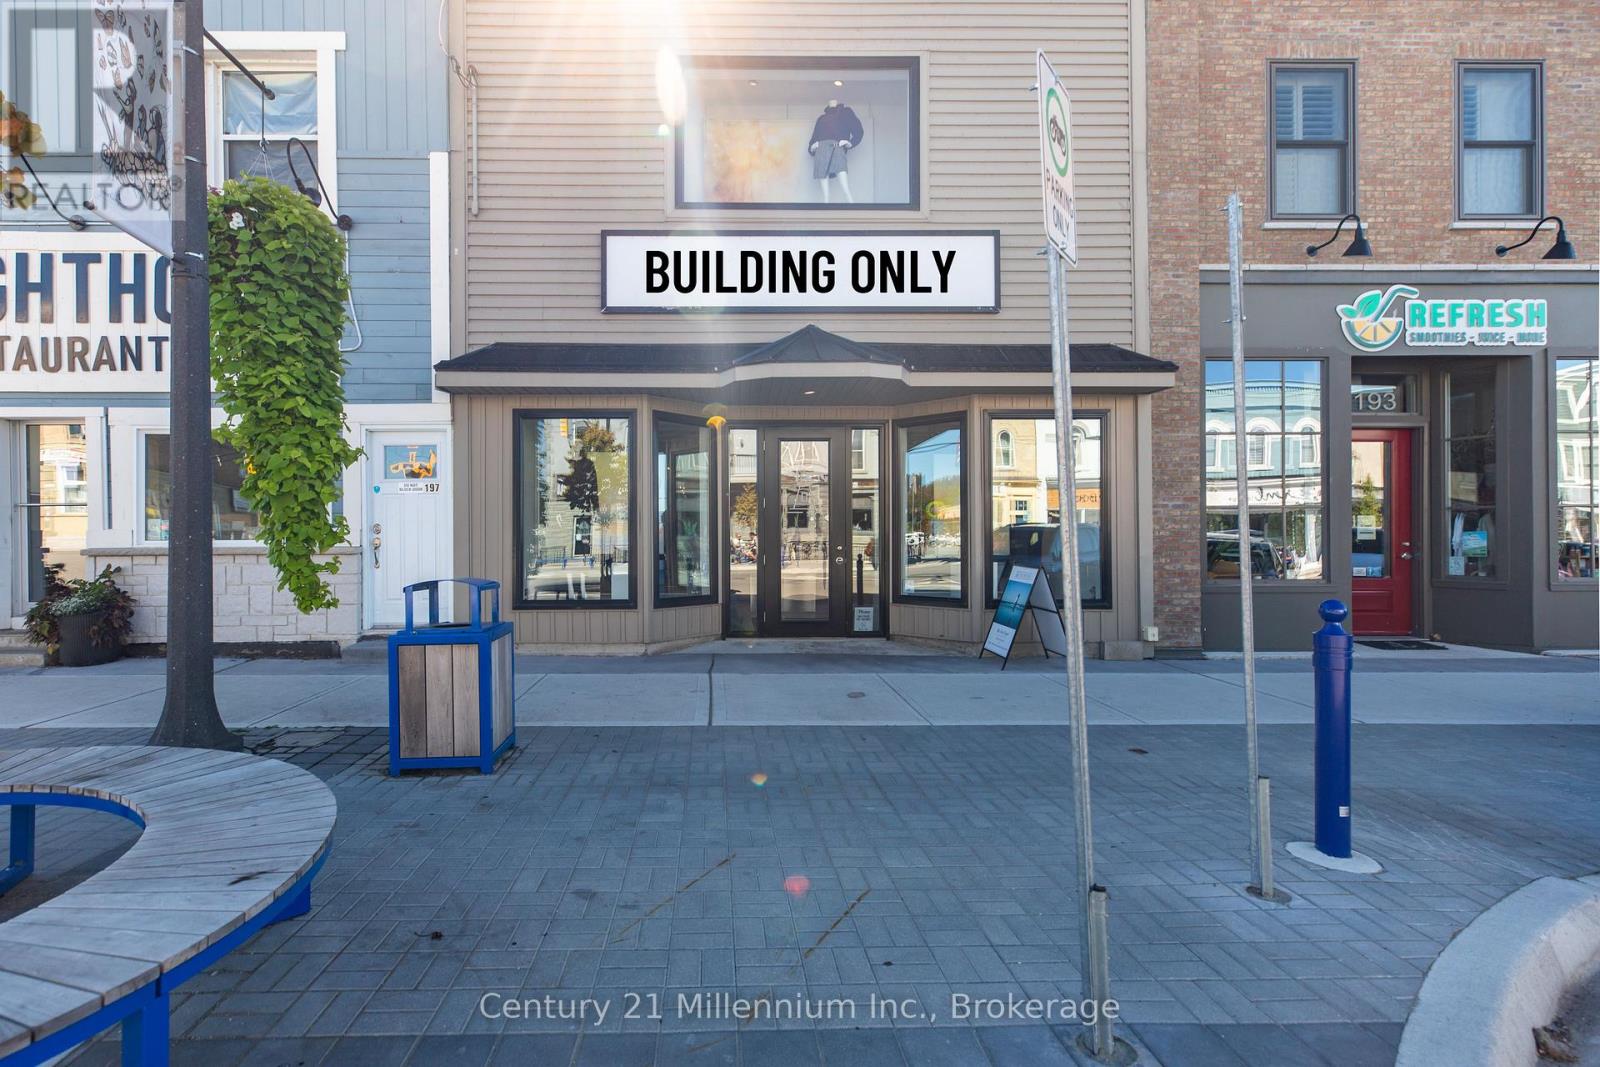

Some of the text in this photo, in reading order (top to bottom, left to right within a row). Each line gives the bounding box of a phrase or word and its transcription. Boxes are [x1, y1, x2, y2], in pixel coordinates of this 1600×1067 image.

[1045, 168, 1073, 219] PARKING
[1053, 204, 1070, 238] ONLY
[645, 250, 957, 294] BUILDING ONLY
[1408, 302, 1546, 328] REFRESH
[1409, 331, 1467, 343] SMOOTHIES
[1477, 331, 1506, 343] JUICE
[1354, 392, 1397, 411] 193
[425, 483, 440, 492] 197
